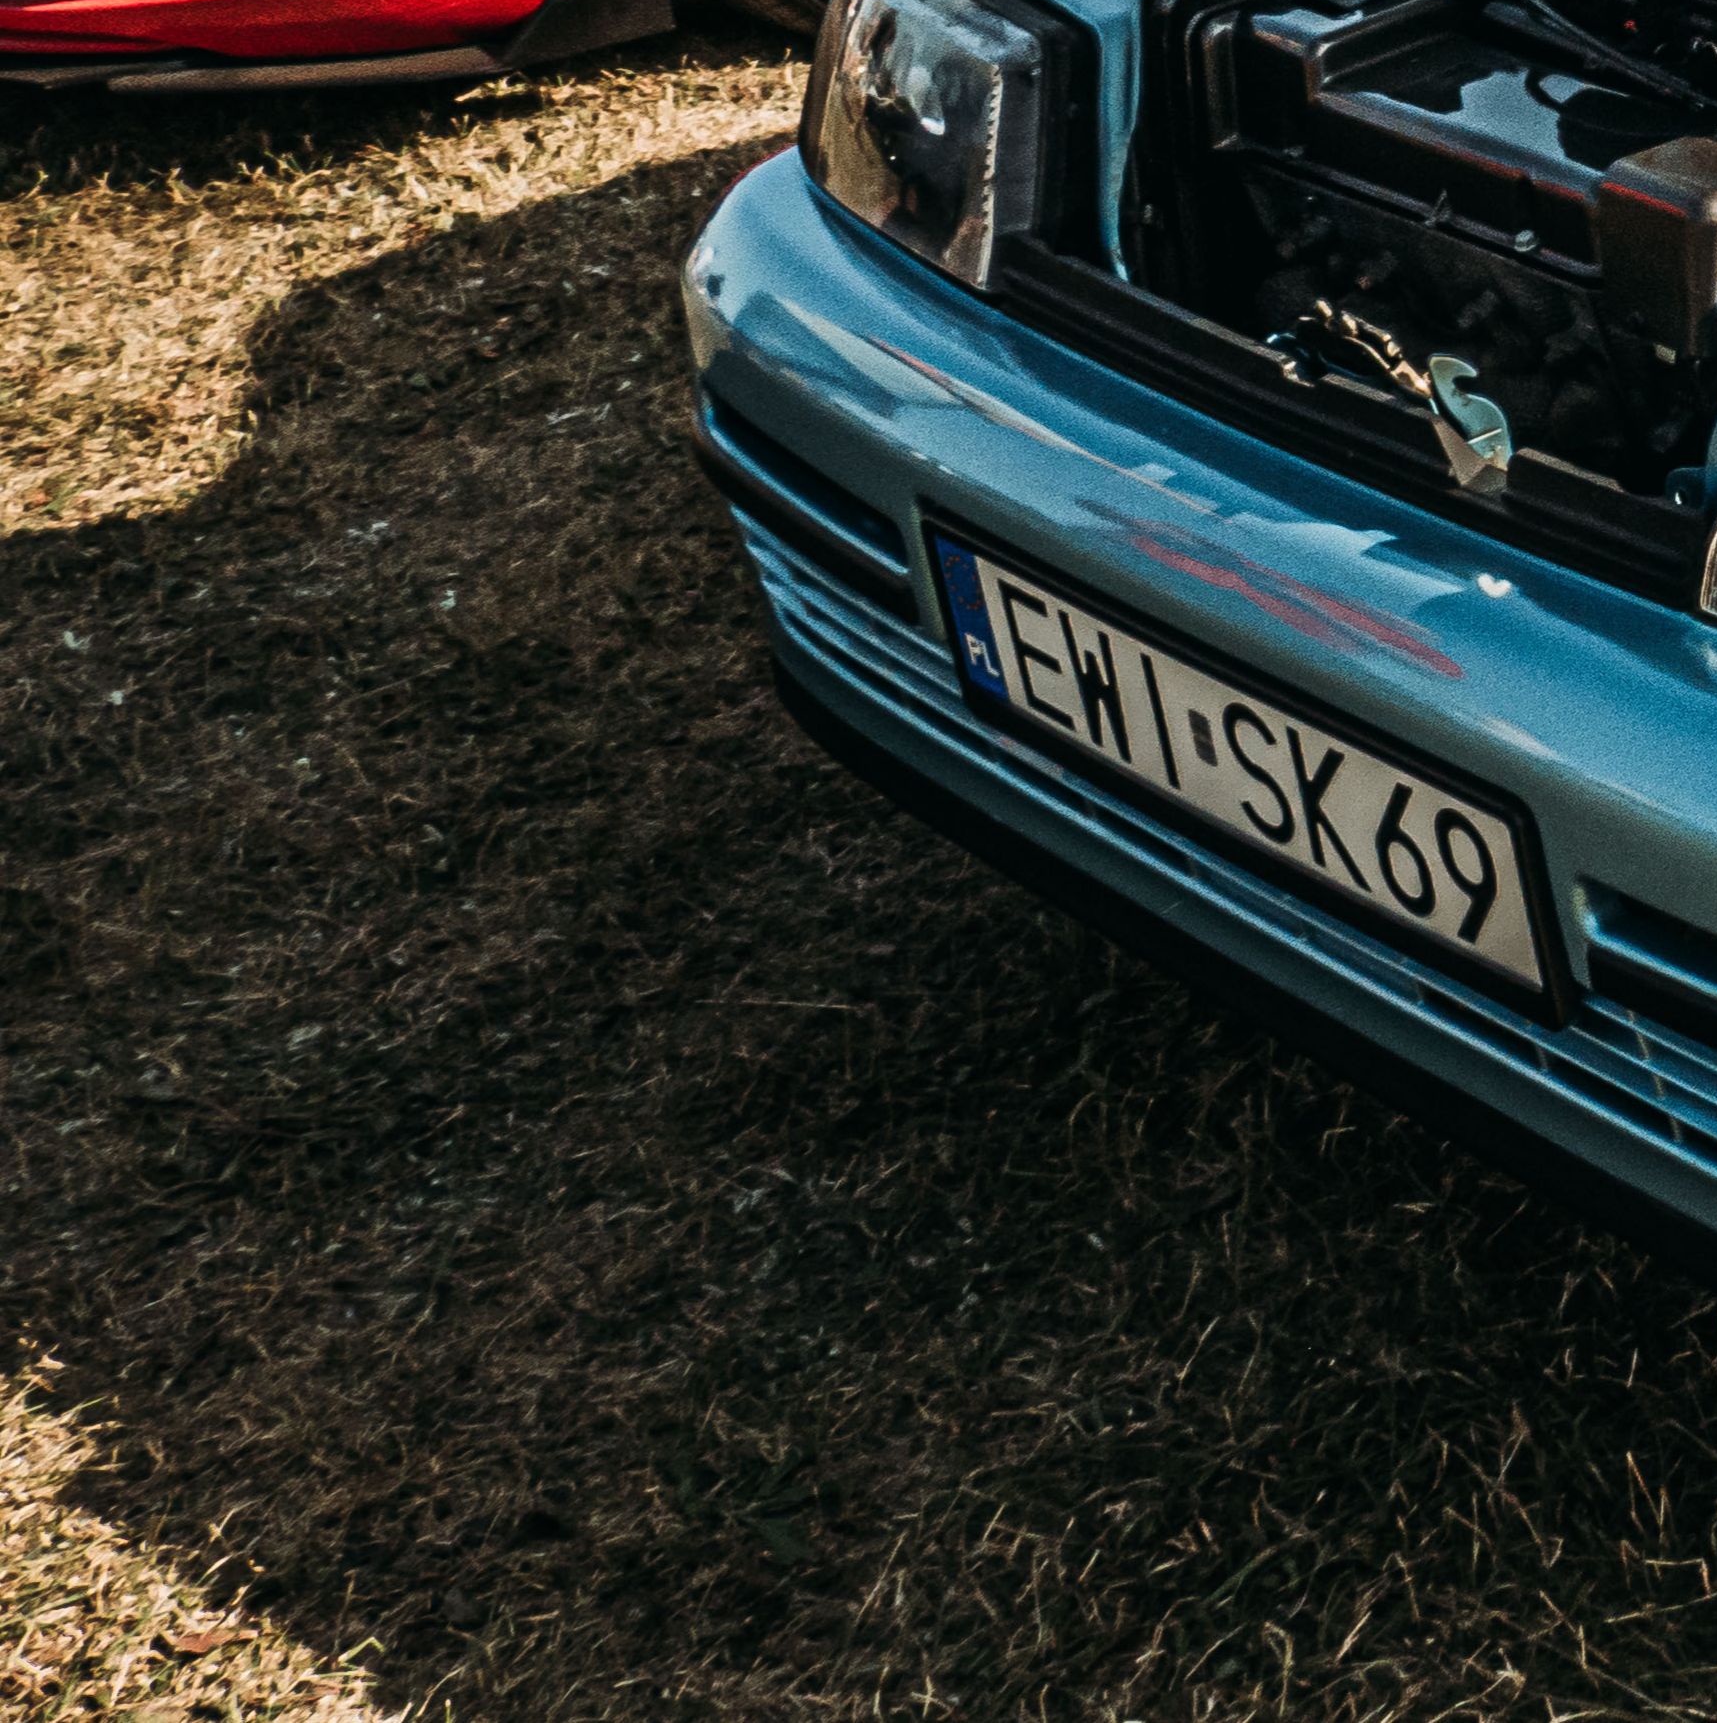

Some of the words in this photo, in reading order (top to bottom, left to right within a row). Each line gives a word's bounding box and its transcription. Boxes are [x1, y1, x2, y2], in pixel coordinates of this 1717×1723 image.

[964, 632, 1000, 678] PL
[998, 577, 1181, 790] EWI
[1222, 701, 1498, 945] SK69
